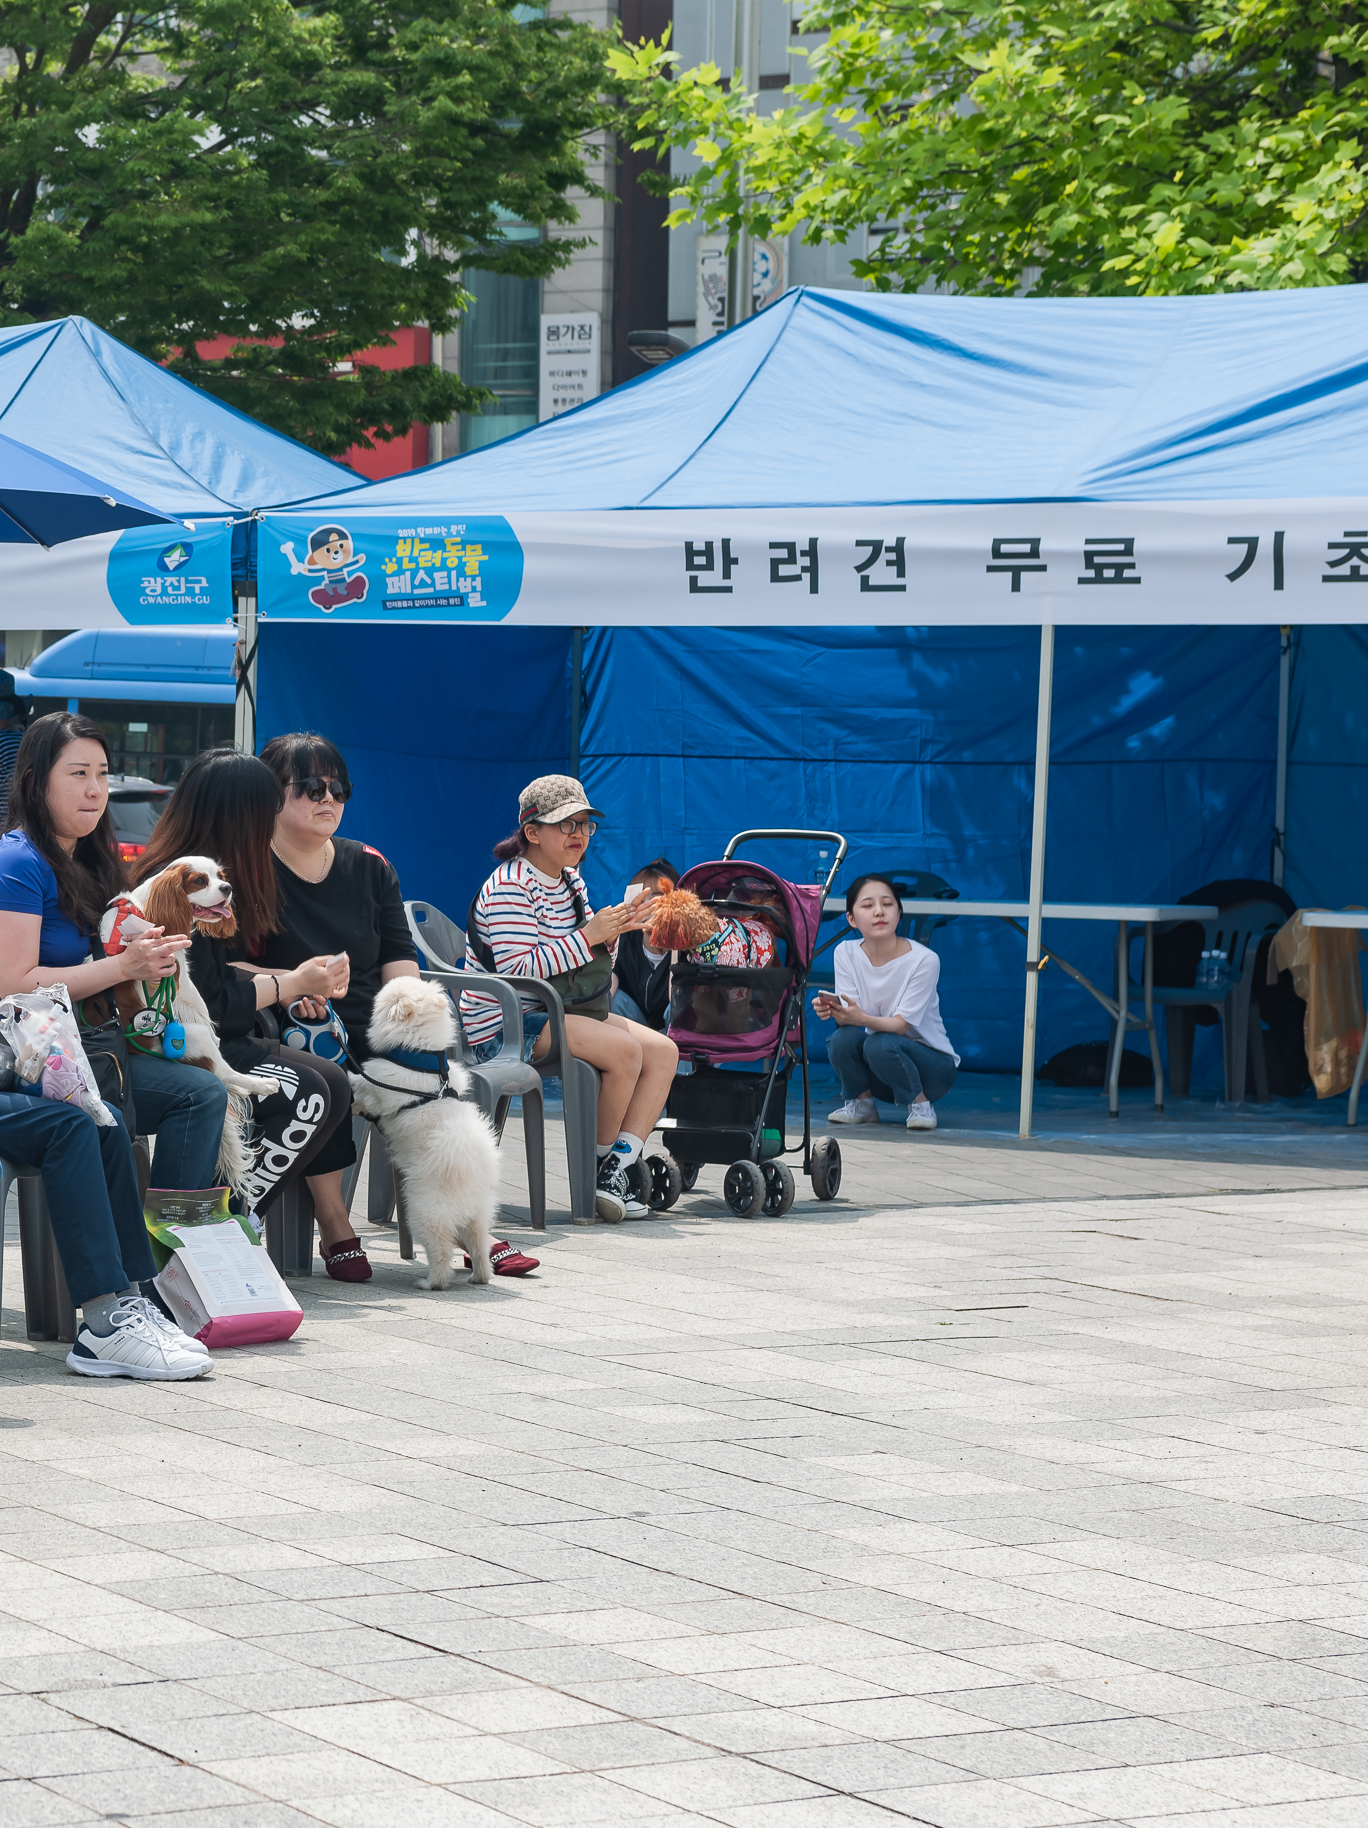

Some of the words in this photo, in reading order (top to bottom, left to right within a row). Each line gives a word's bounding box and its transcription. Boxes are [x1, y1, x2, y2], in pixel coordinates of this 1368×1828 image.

[547, 324, 592, 341] 몸가짐
[398, 529, 416, 537] 2019
[450, 524, 466, 535] 광진
[396, 537, 489, 575] 반려동물
[684, 537, 907, 594] 반려견
[986, 537, 1142, 593] 무료
[140, 576, 209, 595] 광진구
[385, 569, 487, 607] 페스티벌
[139, 595, 210, 605] GWANGJIN-GU
[247, 1093, 325, 1212] didas
